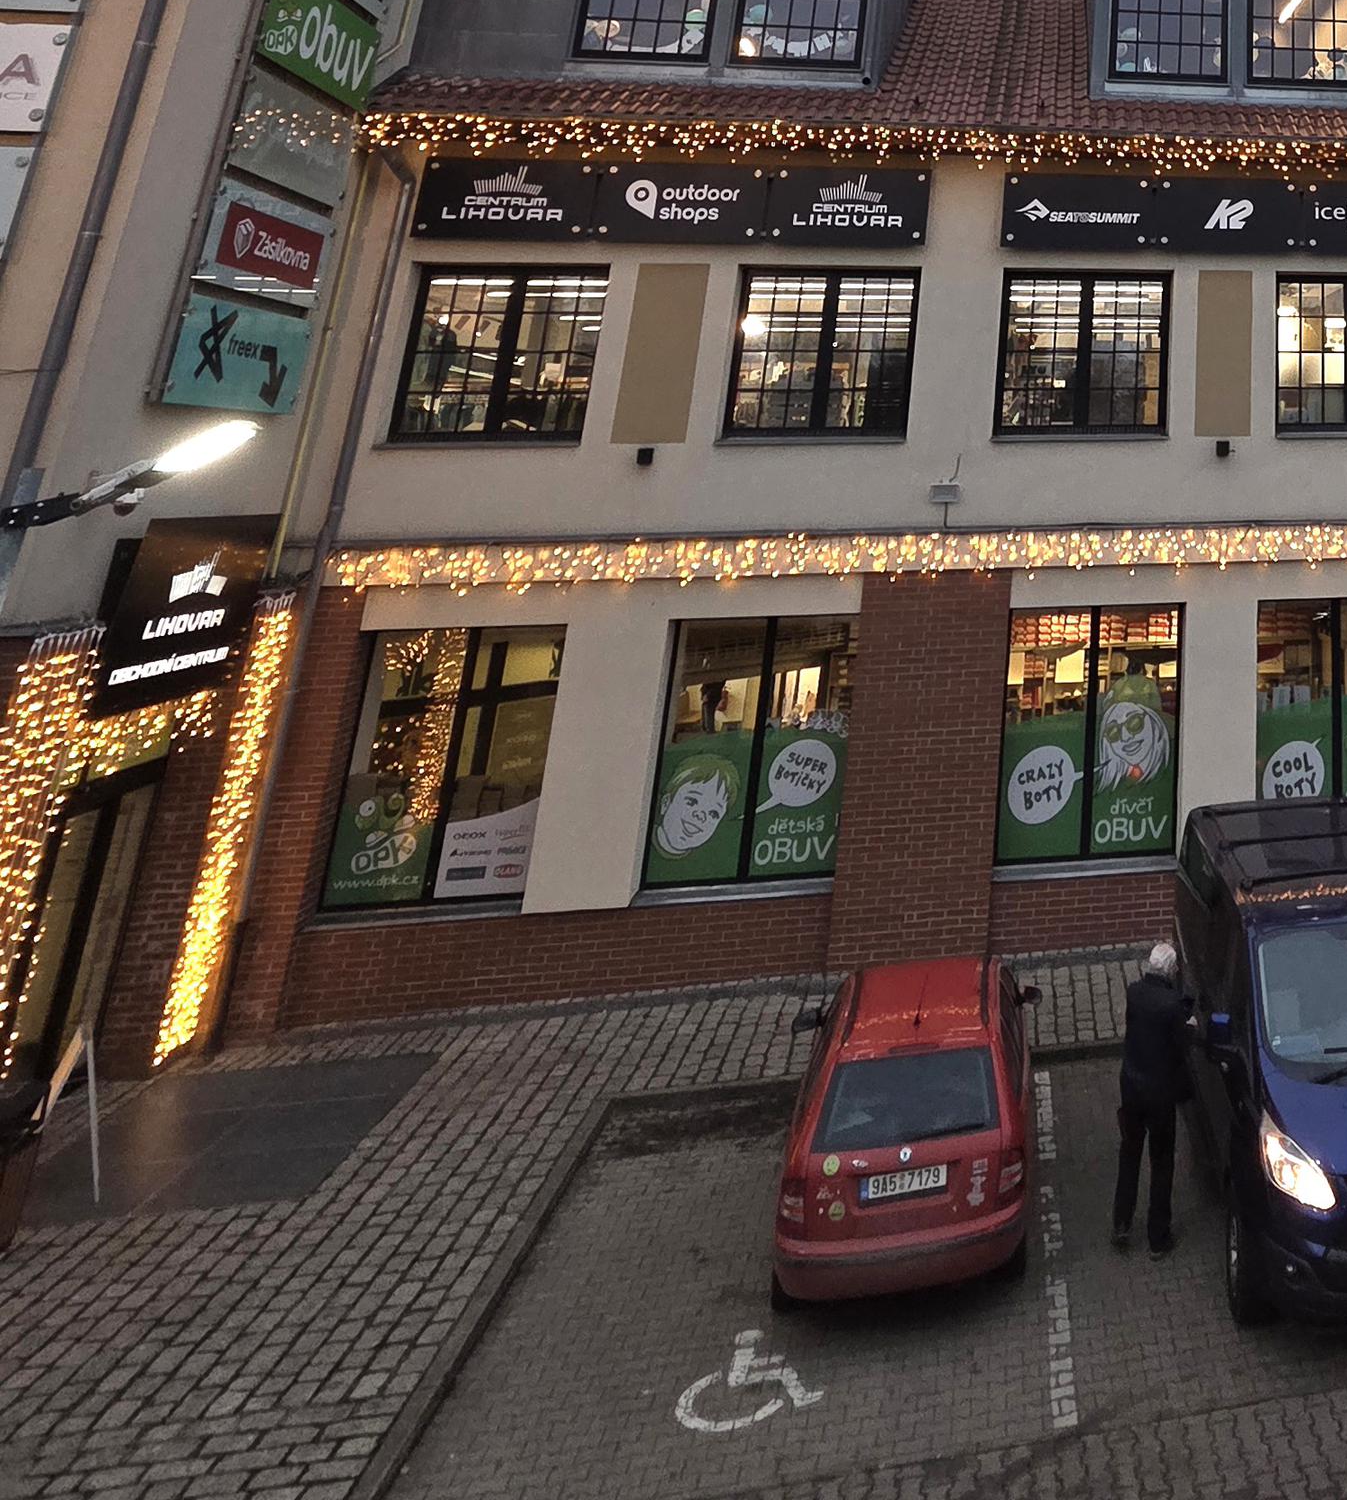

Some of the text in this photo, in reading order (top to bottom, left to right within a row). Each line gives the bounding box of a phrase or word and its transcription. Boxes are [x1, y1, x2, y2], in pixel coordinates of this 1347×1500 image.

[267, 26, 297, 54] DPK
[300, 4, 374, 91] Obuv
[464, 196, 548, 206] CENTRUM
[662, 184, 740, 201] outdoor
[441, 207, 563, 221] LIHOVAR
[659, 203, 719, 224] shops
[792, 213, 903, 228] LIHOVAR
[812, 203, 888, 213] CENTRUM
[1203, 199, 1254, 229] K2
[254, 231, 311, 271] Zásilkovna
[227, 334, 261, 361] freex
[142, 608, 226, 640] LIHOVAR
[786, 751, 828, 776] SUPER
[1017, 758, 1065, 786] CRAZY
[1271, 752, 1315, 778] COOL
[1023, 780, 1064, 811] BOTY
[1110, 796, 1155, 815] dívčí
[767, 814, 826, 836] dětská
[1094, 814, 1169, 844] OBUV
[354, 834, 411, 872] DPK
[754, 834, 835, 866] OBUV
[333, 874, 419, 890] www.dpk.cz
[871, 1167, 941, 1196] 9A5 7179
